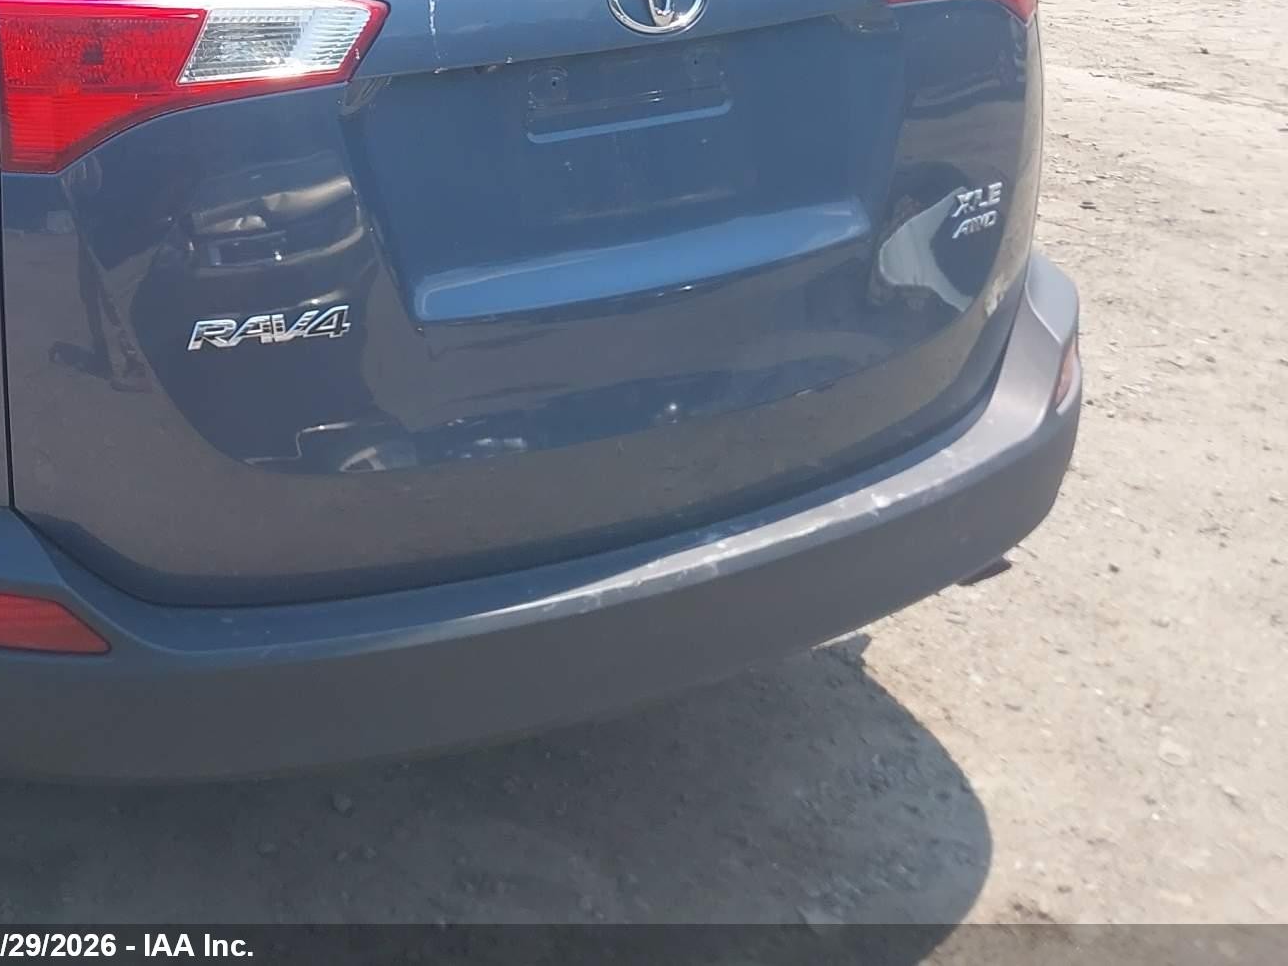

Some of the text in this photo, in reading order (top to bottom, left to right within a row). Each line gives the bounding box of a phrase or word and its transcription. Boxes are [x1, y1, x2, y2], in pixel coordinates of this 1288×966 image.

[952, 181, 1003, 218] XLE
[952, 210, 998, 239] AWD
[187, 305, 352, 350] RAV4
